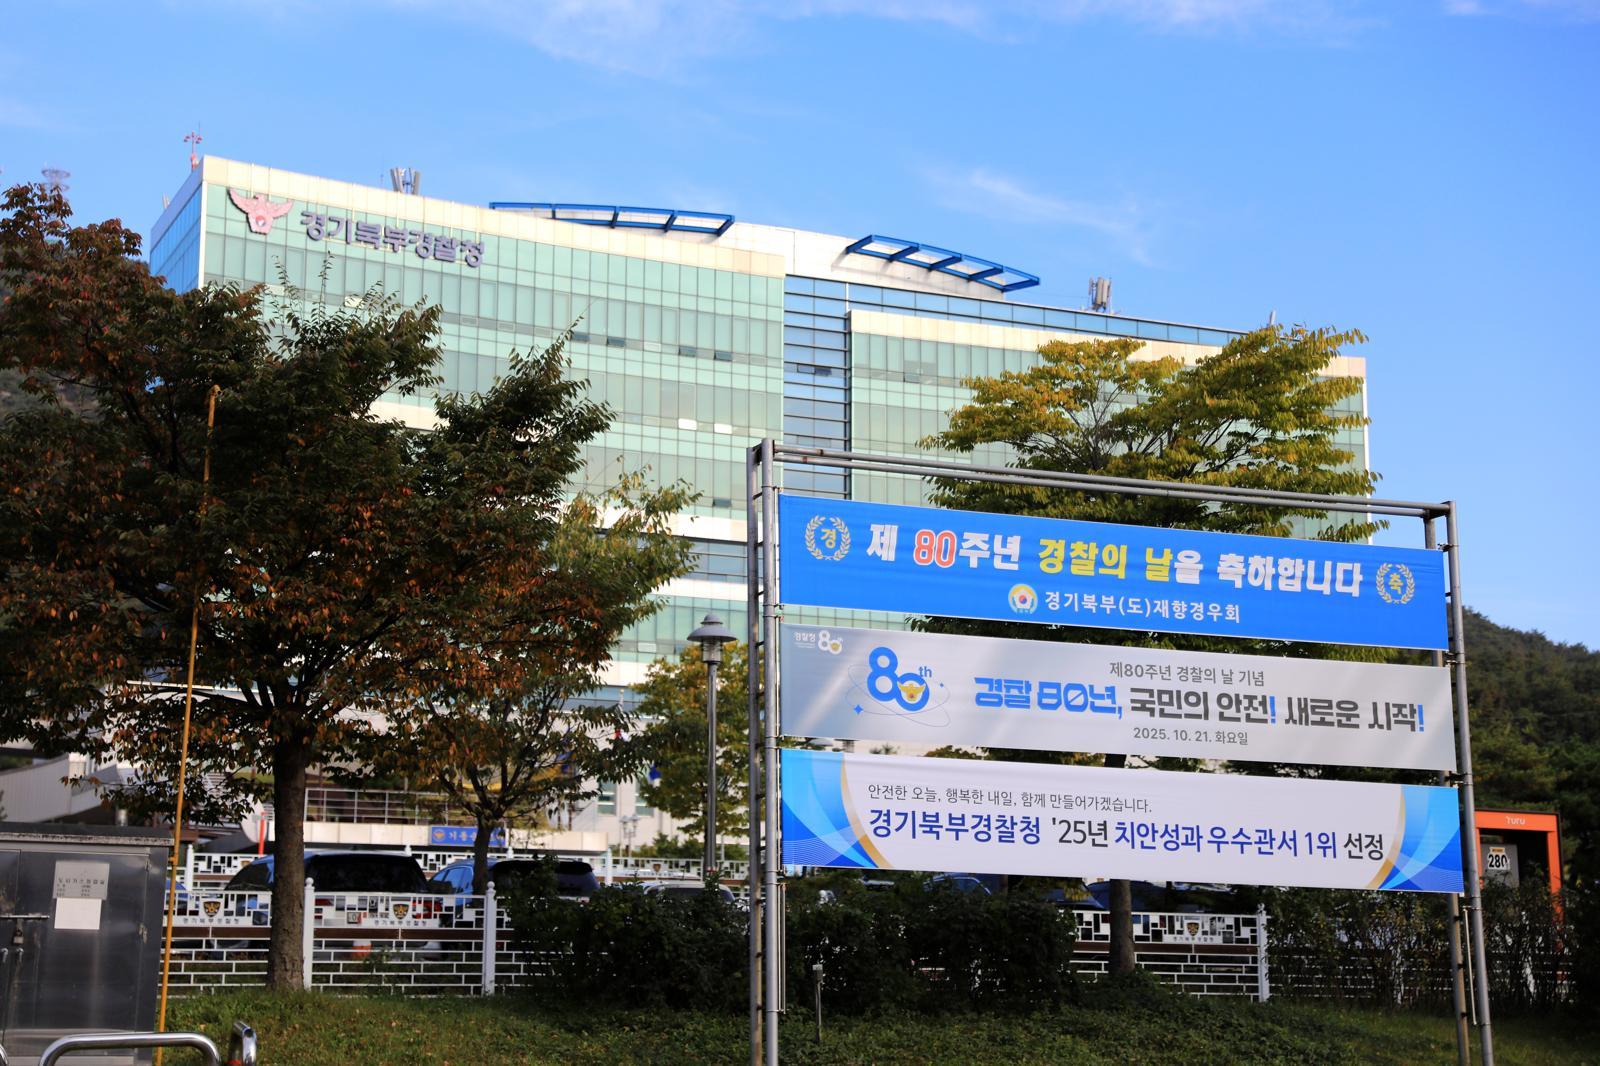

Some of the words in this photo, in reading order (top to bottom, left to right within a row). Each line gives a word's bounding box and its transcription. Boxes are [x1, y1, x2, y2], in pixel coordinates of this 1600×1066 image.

[300, 210, 485, 268] 경기북부경찰청
[820, 528, 837, 549] 경
[867, 523, 899, 561] 제
[913, 529, 1021, 571] 80주년
[1038, 538, 1128, 580] 경찰의
[1145, 547, 1204, 585] 날을
[1216, 552, 1363, 597] 축하합니다
[1388, 573, 1404, 594] 축
[1045, 591, 1241, 624] 경기북부(도)재향경우회
[1109, 661, 1172, 682] 제80주년
[1176, 664, 1216, 684] 경찰의
[1221, 666, 1234, 685] 날
[1239, 669, 1264, 687] 기념
[974, 677, 1032, 710] 경찰
[1037, 681, 1123, 720] 80년,
[1130, 687, 1209, 721] 국민의
[1216, 691, 1277, 724] 안전!
[1285, 696, 1360, 729] 새로운
[1367, 701, 1425, 732] 시작!
[1133, 727, 1170, 741] 2025.
[1174, 729, 1192, 742] 10.
[1195, 730, 1212, 743] 21.
[1215, 731, 1249, 746] 화요일
[868, 784, 907, 801] 안전한
[912, 786, 941, 803] 오늘,
[945, 788, 984, 805] 행복한
[987, 790, 1017, 807] 내일,
[1021, 791, 1046, 808] 함께
[1050, 793, 1152, 813] 만들어가겠습니다.
[869, 808, 1041, 845] 경기북부경찰청
[1051, 817, 1109, 848] '25년
[1114, 821, 1203, 852] 치안성과
[1206, 826, 1298, 857] 우수관서
[1304, 831, 1337, 859] 1위
[1343, 833, 1384, 861] 선정
